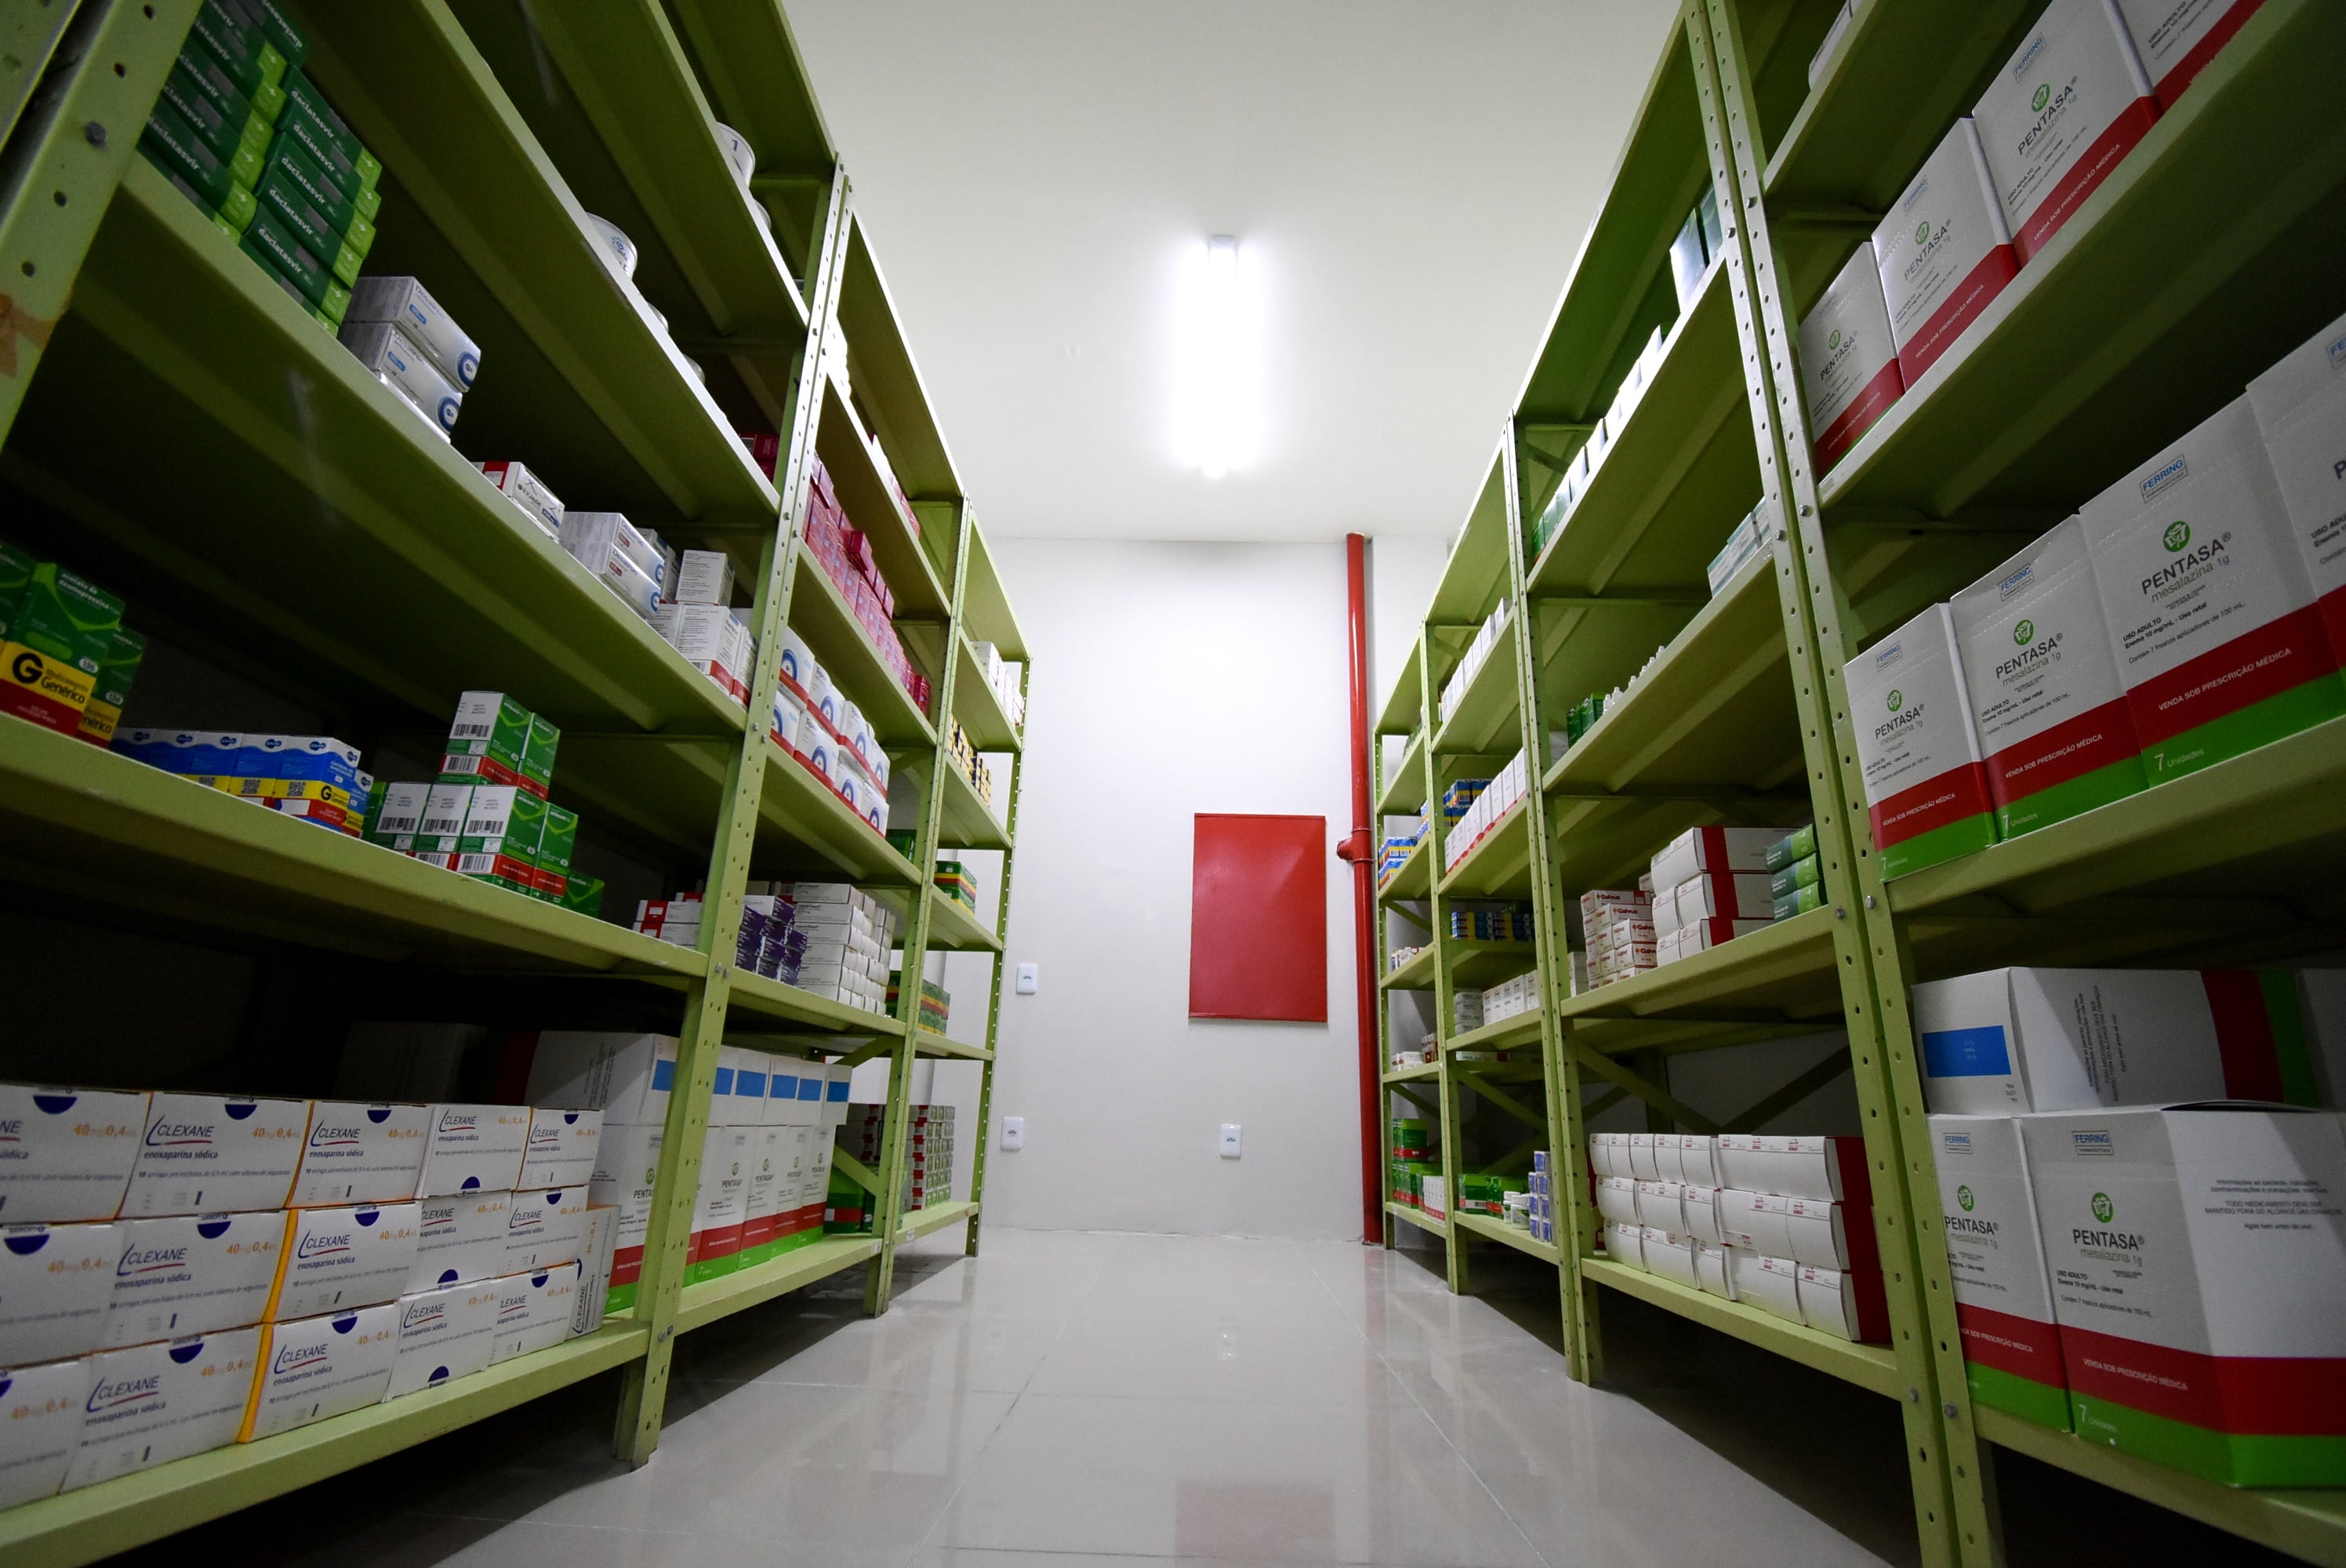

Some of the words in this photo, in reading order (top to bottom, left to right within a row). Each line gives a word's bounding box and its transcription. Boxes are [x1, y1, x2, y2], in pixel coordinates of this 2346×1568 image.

[2142, 459, 2184, 492] FERRING
[2001, 567, 2032, 592] FERRING
[2152, 563, 2214, 603] mesalazina
[2137, 617, 2162, 635] ADULTO
[2159, 695, 2184, 710] VENDA
[2184, 688, 2201, 699] SOB
[2202, 663, 2254, 692] PRESCRIÇÃO
[2256, 648, 2292, 668] MÉDICA
[41, 677, 85, 704] Genérico
[2005, 767, 2024, 778] VENDA
[2024, 760, 2036, 771] SOB
[2037, 745, 2075, 765] PRESCRIÇÃO
[2076, 734, 2103, 749] MÉDICA
[2154, 753, 2164, 771] 7
[157, 1124, 215, 1138] CLEXANE
[318, 1128, 361, 1138] CLEXANE
[306, 1234, 351, 1249] CLEXANE
[127, 1247, 188, 1265] CLEXANE
[282, 1343, 328, 1364] CLEXANE
[98, 1376, 161, 1400] CLEXANE
